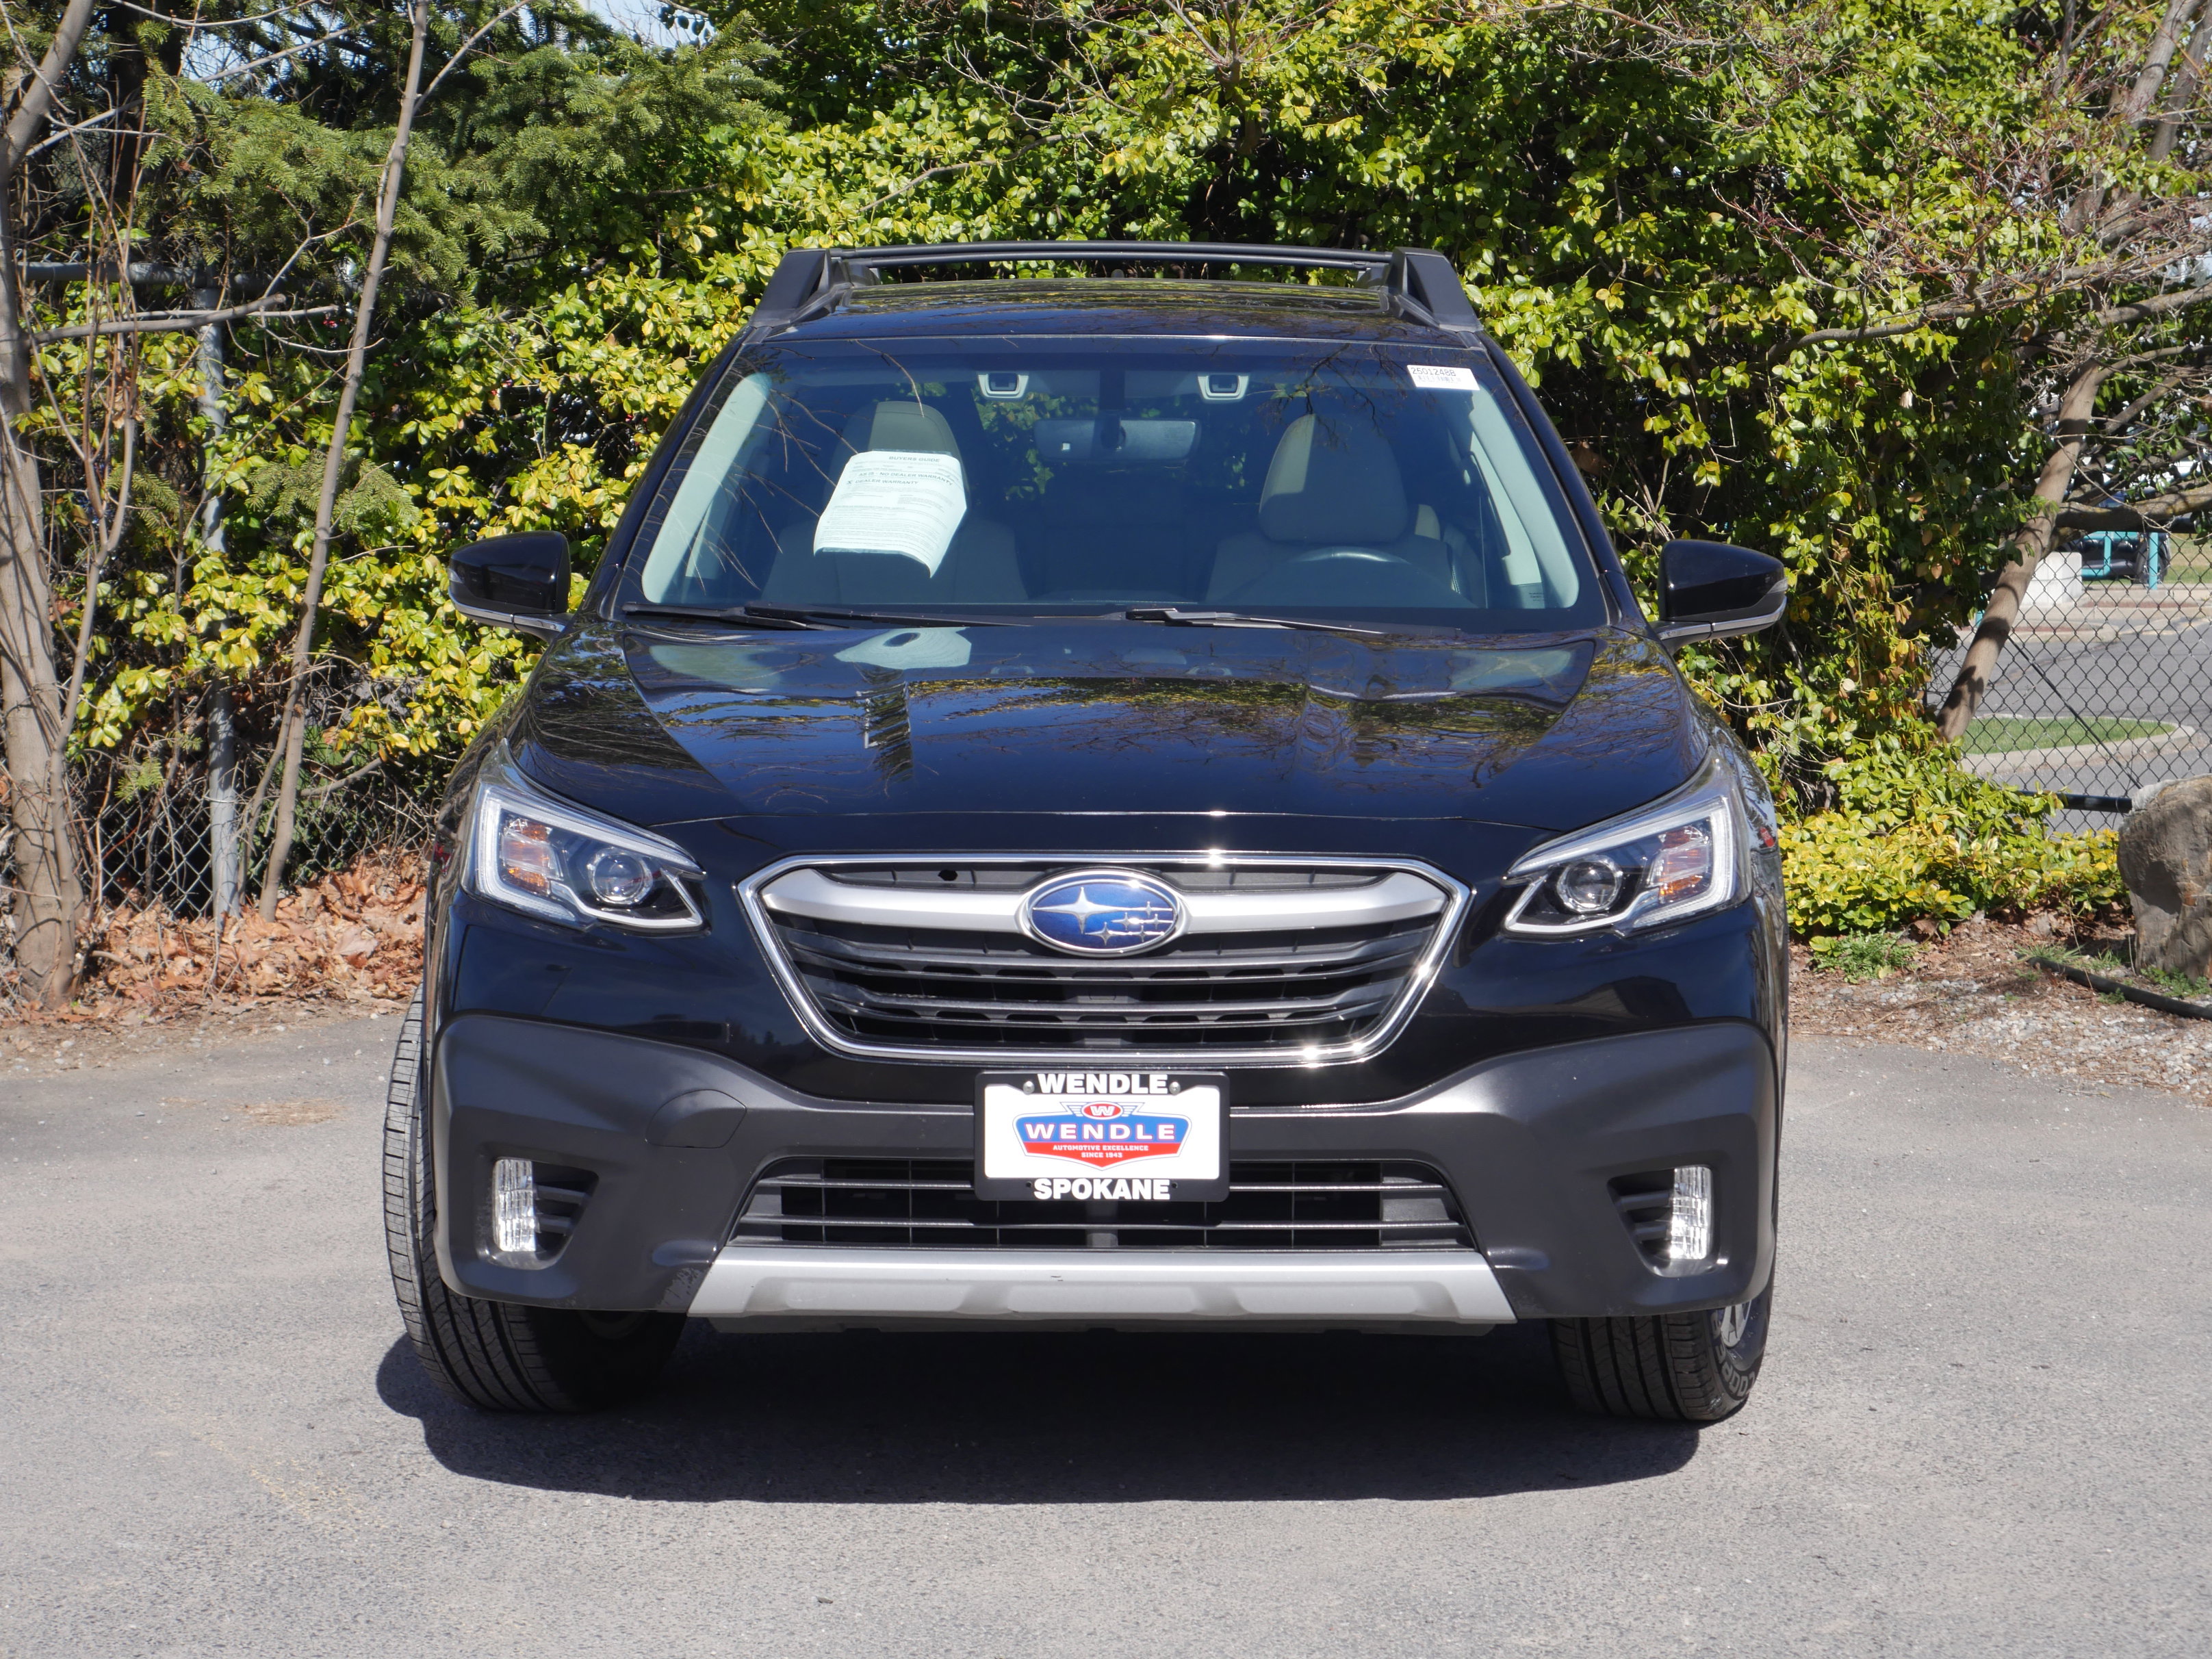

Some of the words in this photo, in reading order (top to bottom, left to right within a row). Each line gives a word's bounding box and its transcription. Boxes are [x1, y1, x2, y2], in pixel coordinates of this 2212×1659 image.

[1038, 1073, 1168, 1094] WENDLE
[1090, 1105, 1115, 1116] W
[1025, 1123, 1175, 1140] WENDLE
[1033, 1177, 1170, 1200] SPOKANE
